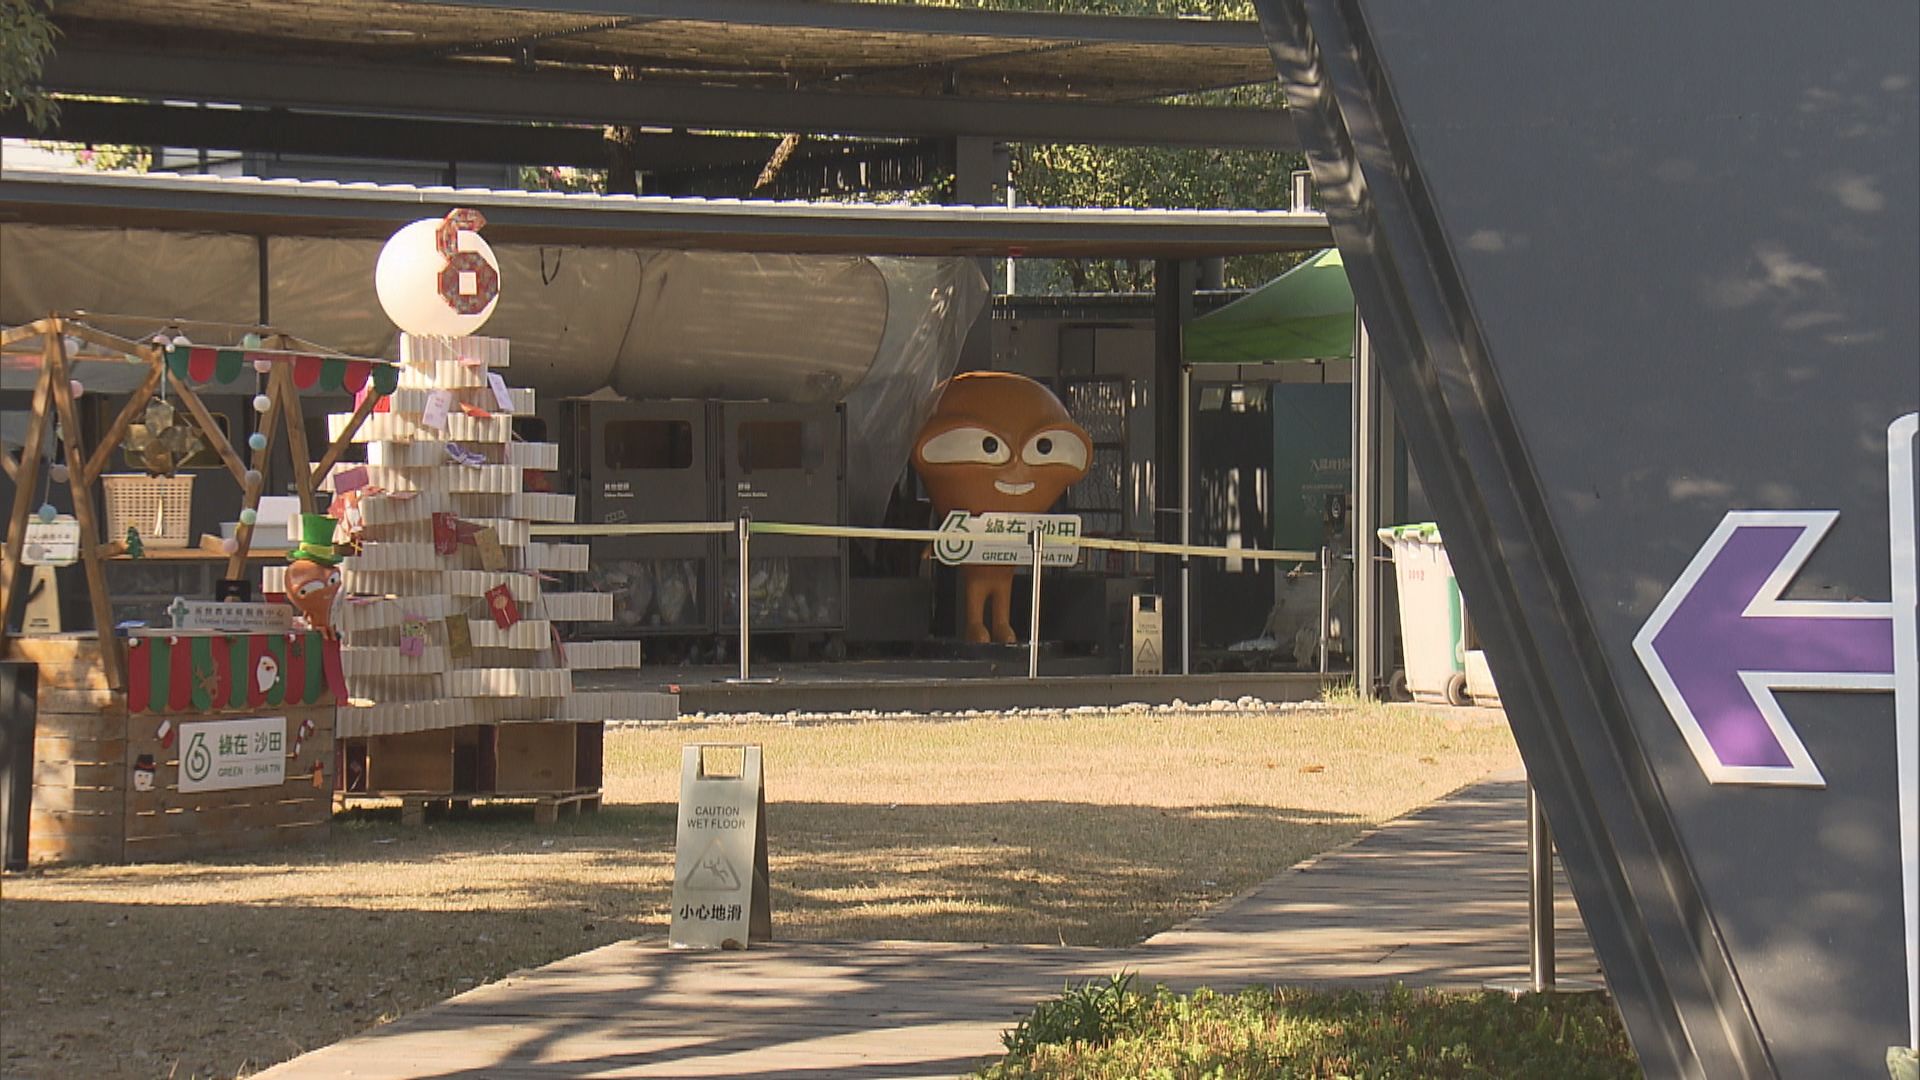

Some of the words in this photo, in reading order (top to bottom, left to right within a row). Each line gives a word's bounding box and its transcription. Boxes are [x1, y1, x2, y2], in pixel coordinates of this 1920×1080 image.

[982, 551, 1018, 561] GREEN
[1057, 553, 1073, 563] TIN
[218, 734, 249, 755] 綠在
[255, 731, 282, 753] 沙田
[217, 765, 243, 777] GREEN
[695, 806, 740, 816] CAUTION
[687, 819, 708, 829] WET
[711, 819, 745, 829] FLOOR
[680, 903, 742, 921] 小心地滑
